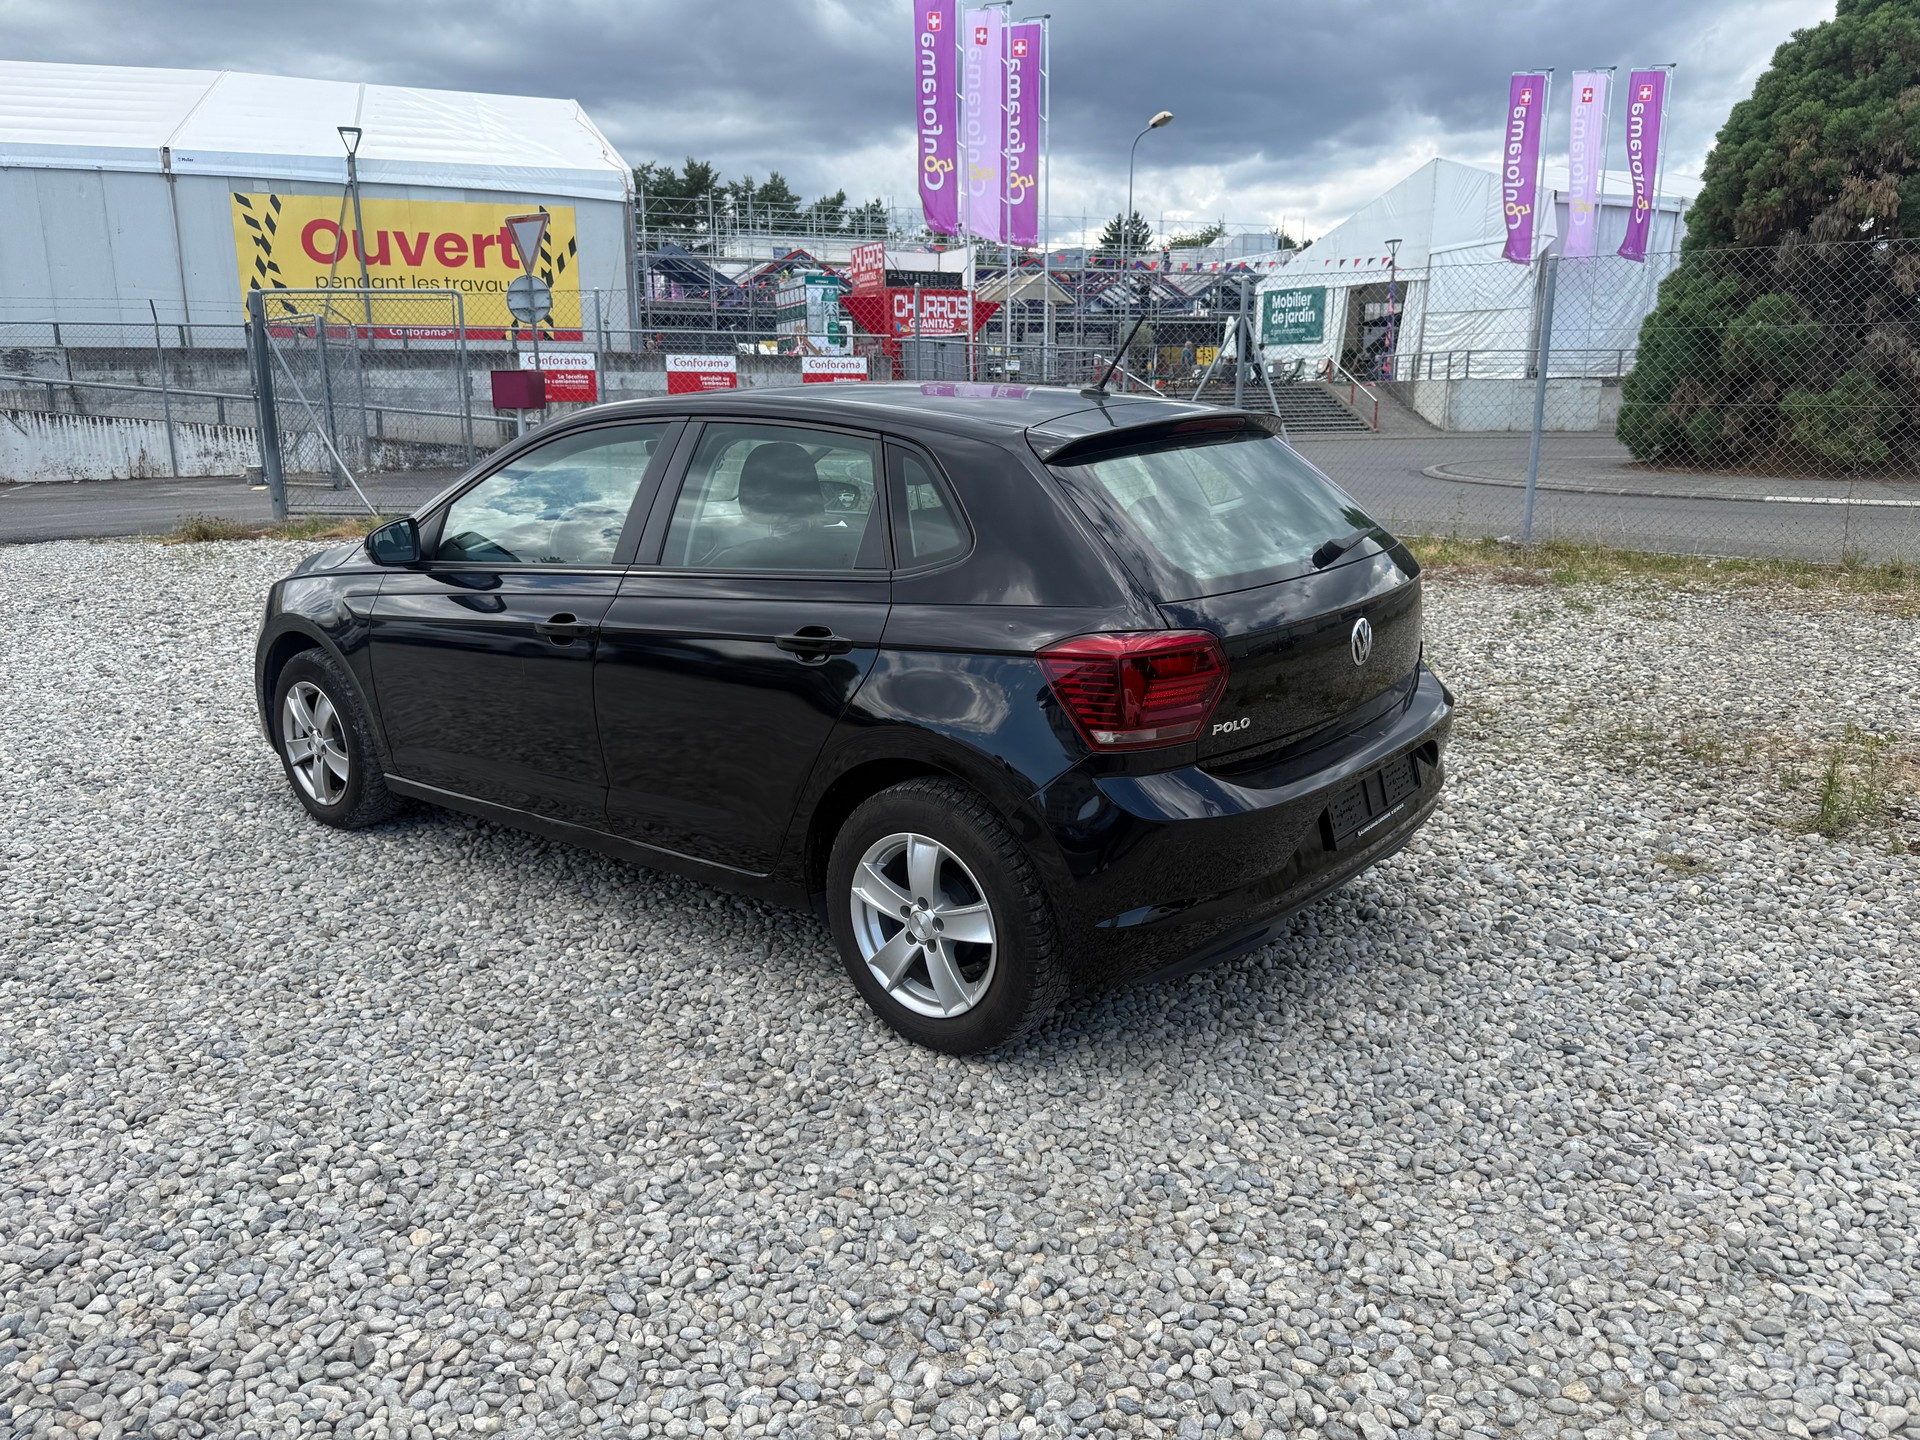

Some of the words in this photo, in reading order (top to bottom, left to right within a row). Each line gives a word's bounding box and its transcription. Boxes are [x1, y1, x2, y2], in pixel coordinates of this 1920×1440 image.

[301, 218, 521, 269] Ouvert
[852, 243, 883, 274] CHURROS
[315, 273, 404, 290] pendant
[412, 274, 440, 289] les
[444, 276, 511, 293] travau
[894, 295, 969, 319] CHURROS
[1272, 291, 1312, 309] Mobilier
[909, 318, 955, 329] GANITAS
[1272, 310, 1284, 325] de
[1284, 307, 1315, 328] jardin
[528, 355, 588, 366] Cnforama
[673, 357, 729, 368] Conforama
[809, 359, 861, 369] Conforama
[1211, 717, 1250, 736] POLO
